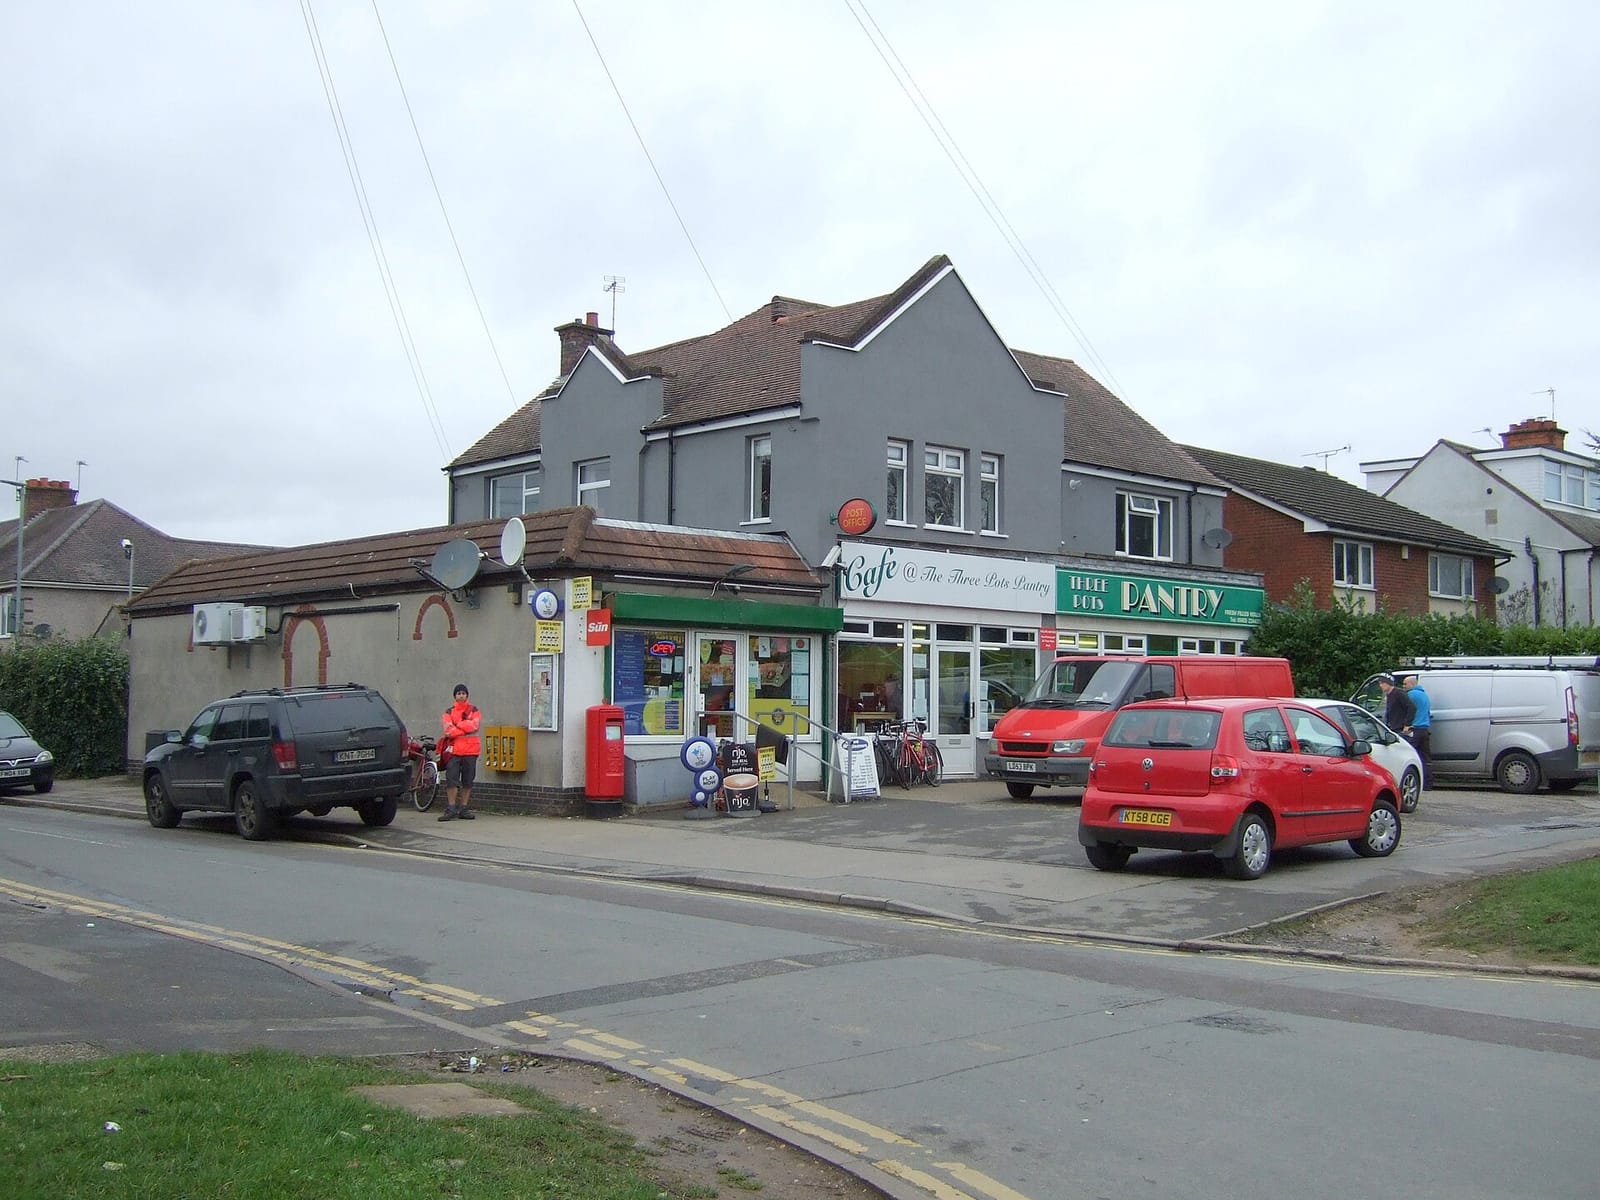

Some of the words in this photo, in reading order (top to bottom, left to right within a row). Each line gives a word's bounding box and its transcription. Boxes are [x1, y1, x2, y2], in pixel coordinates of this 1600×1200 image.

[846, 508, 864, 517] POST
[843, 517, 867, 528] OFFICE
[845, 547, 899, 598] Cafe
[903, 561, 918, 583] @
[920, 566, 943, 583] The
[948, 568, 981, 587] Three
[984, 572, 1010, 590] Pots
[1012, 575, 1051, 598] Pantry
[1069, 576, 1109, 593] THREE
[1073, 594, 1104, 611] POTS
[1121, 581, 1224, 618] PANTRY
[588, 622, 608, 633] Sun
[653, 643, 674, 654] OPEN
[339, 751, 354, 760] KNT
[1124, 811, 1148, 823] KT58
[1150, 813, 1170, 825] CGE
